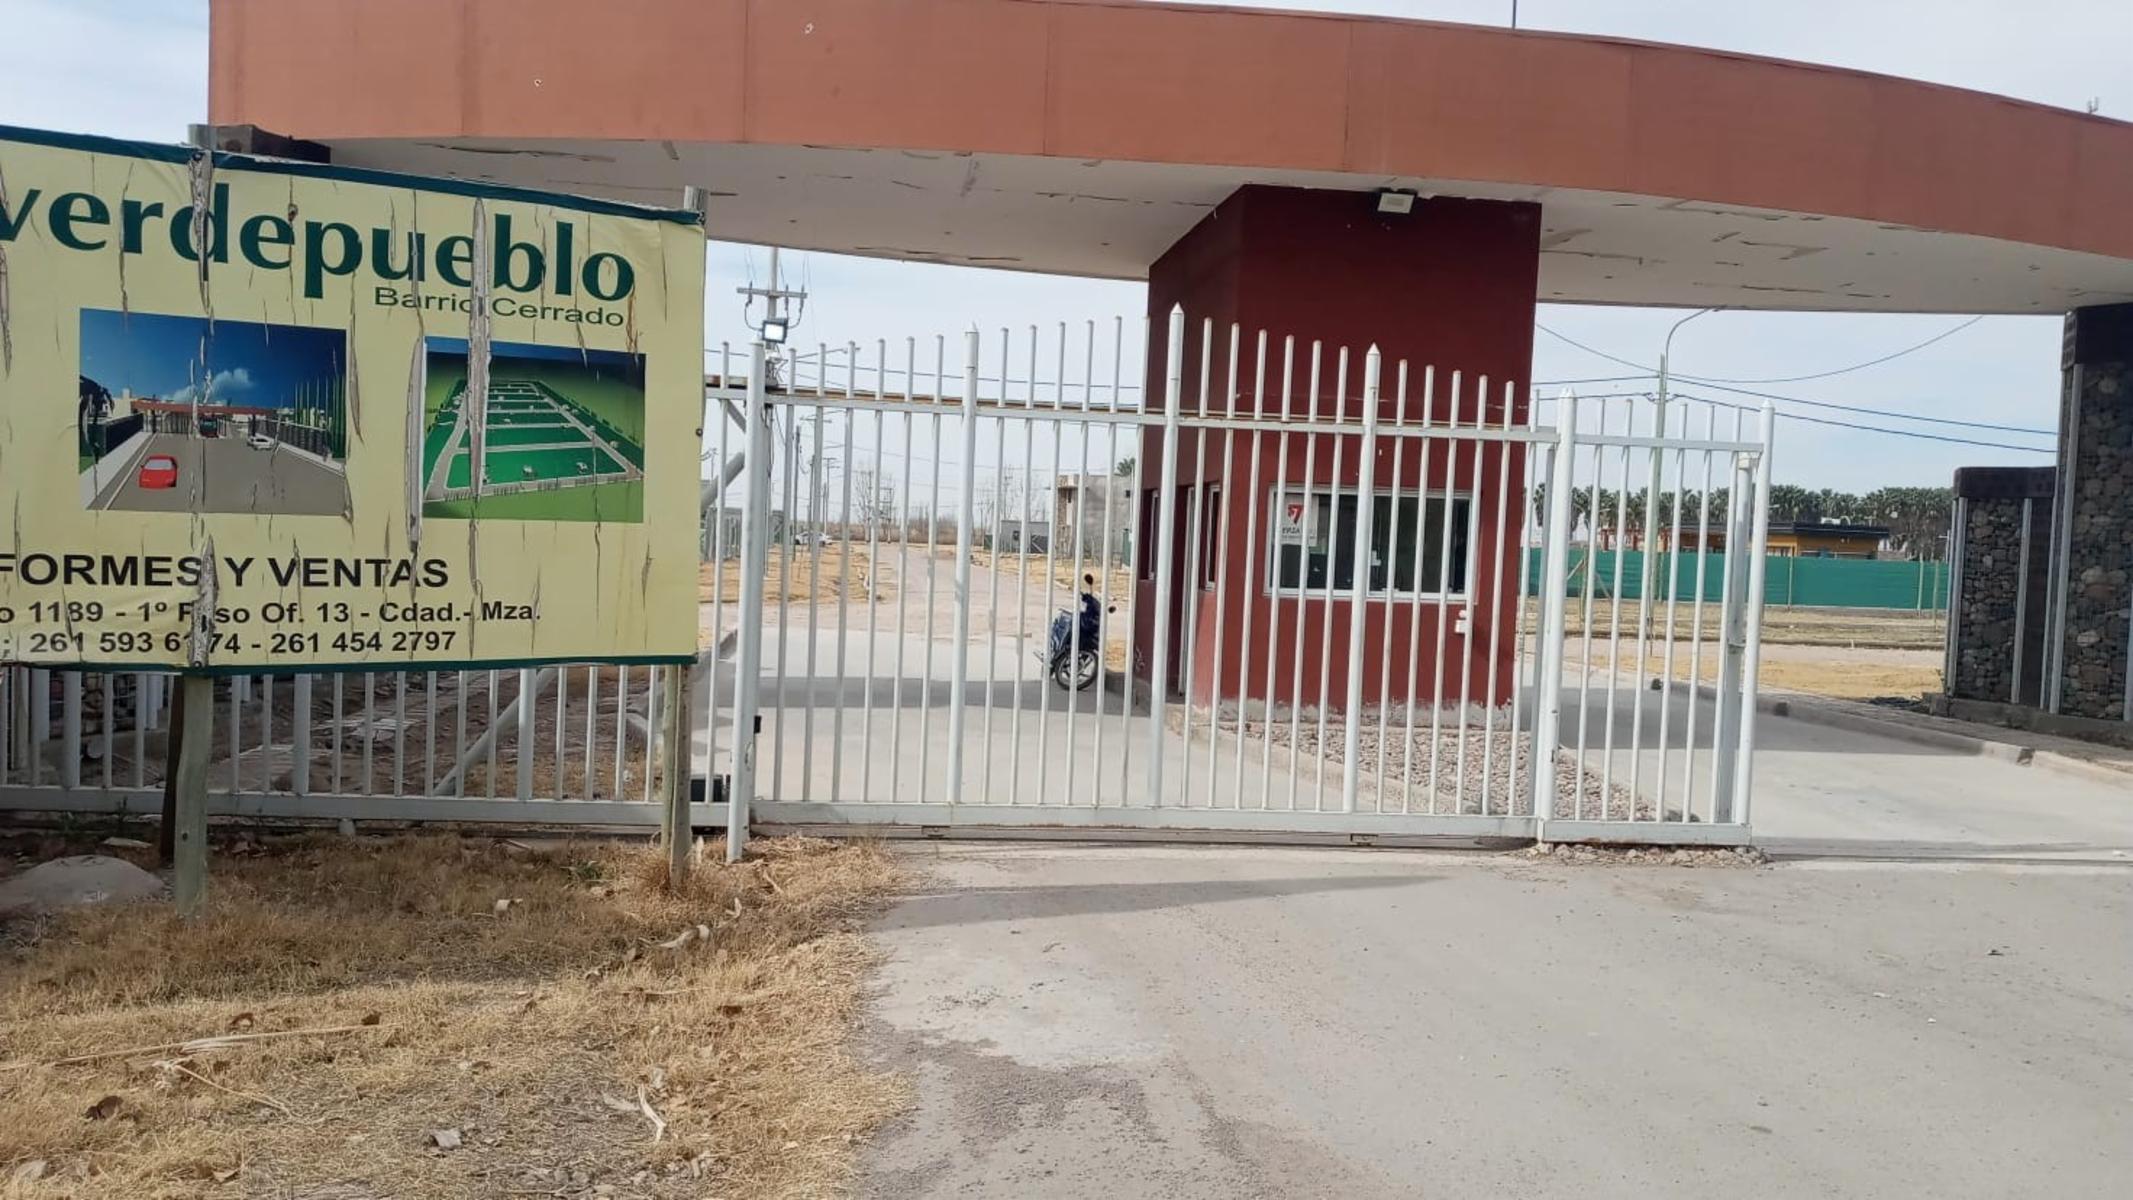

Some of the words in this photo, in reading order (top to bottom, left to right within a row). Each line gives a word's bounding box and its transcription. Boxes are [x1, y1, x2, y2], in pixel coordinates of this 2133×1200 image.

[0, 182, 635, 301] verdepueblo
[492, 297, 625, 327] Cerrado
[223, 557, 254, 587] Y
[267, 557, 449, 588] VENTAS
[28, 601, 104, 623] 1189
[178, 601, 250, 624] Pso
[261, 602, 304, 623] Of.
[316, 602, 349, 623] 13
[481, 600, 541, 622] Mza.
[29, 632, 84, 653] 261
[99, 631, 153, 653] 593
[164, 631, 241, 654] 674
[270, 632, 320, 654] 261
[332, 631, 383, 653] 454
[391, 630, 456, 652] 2797
